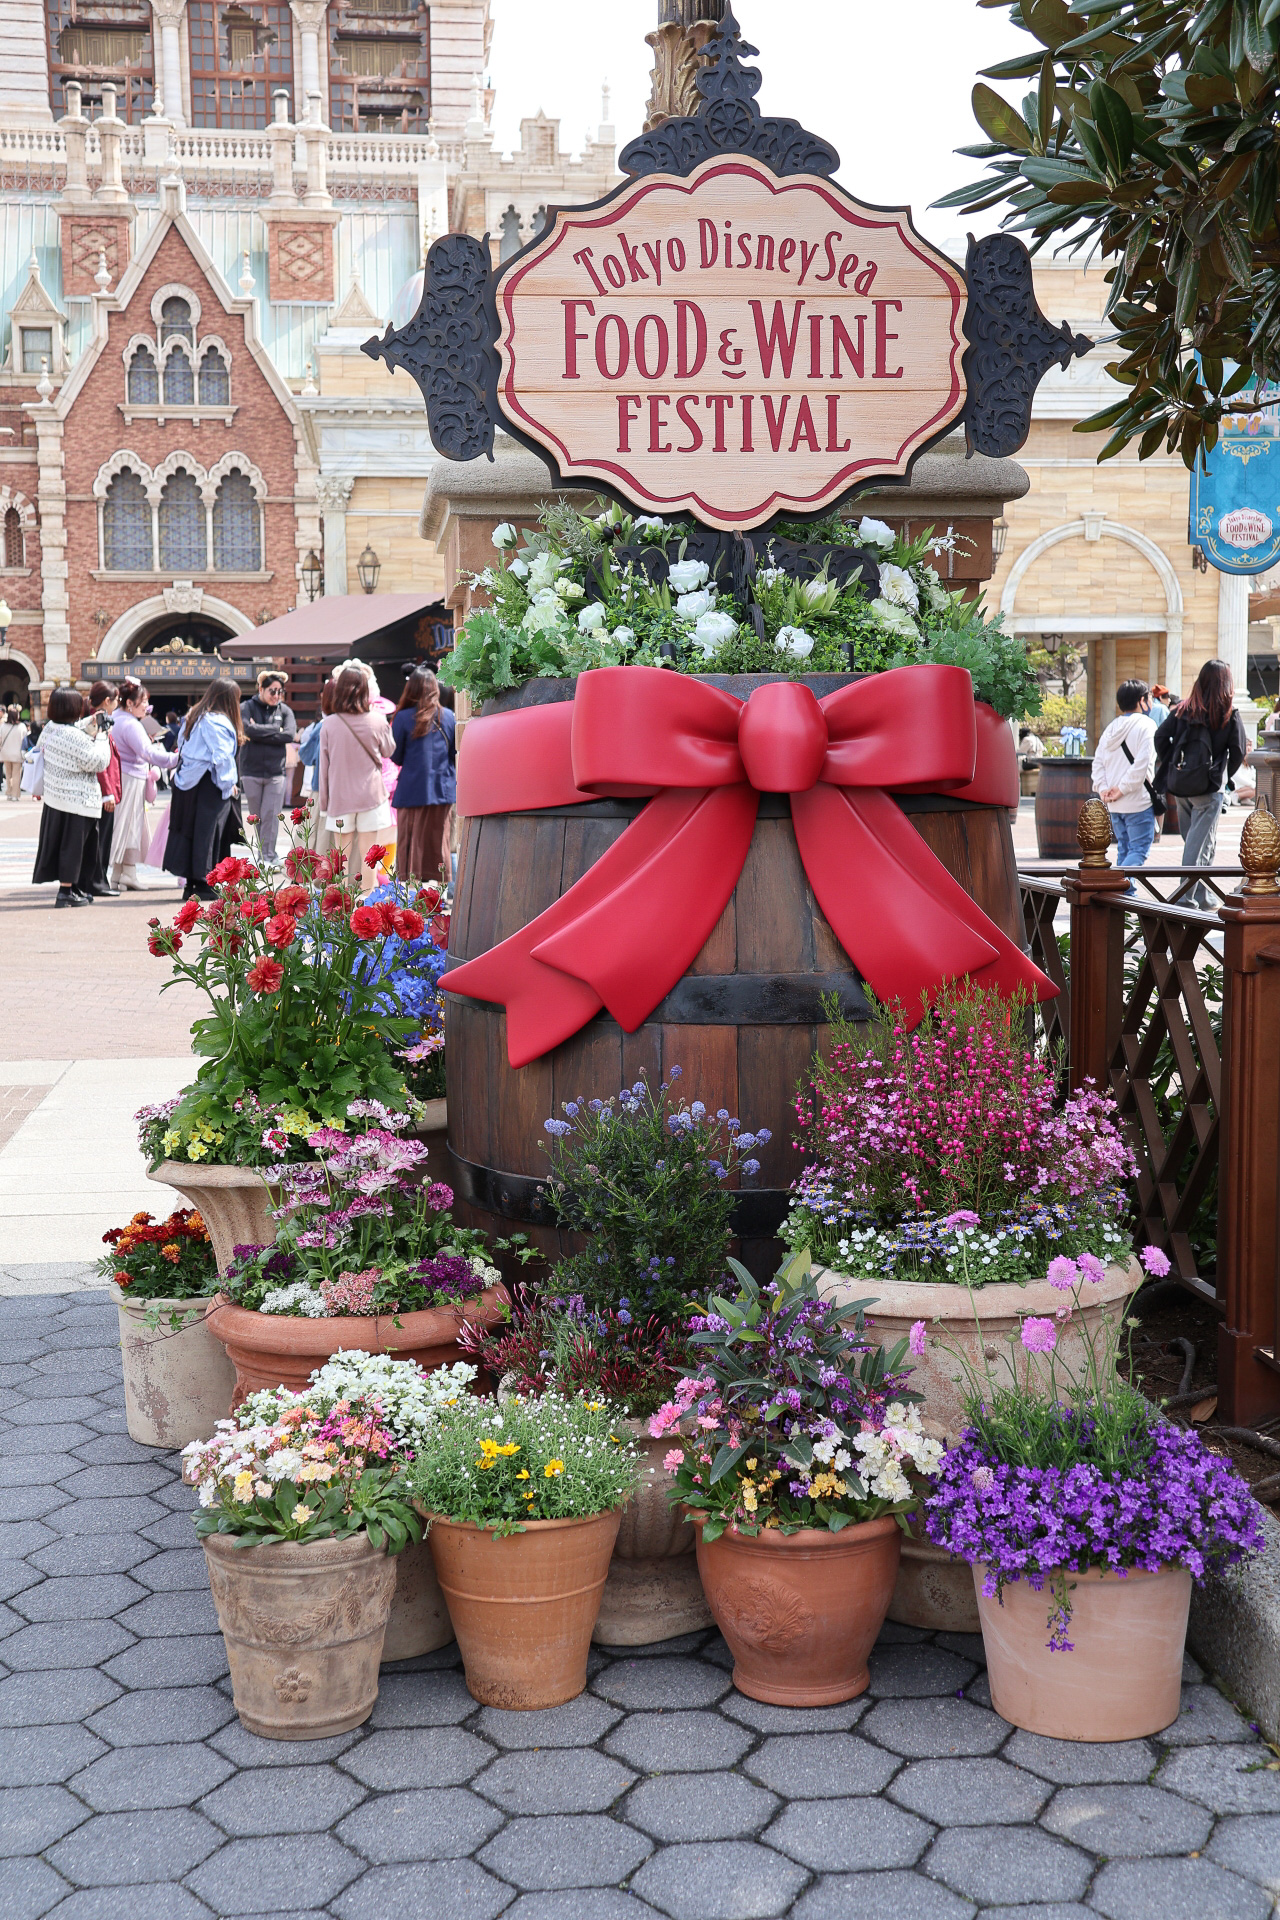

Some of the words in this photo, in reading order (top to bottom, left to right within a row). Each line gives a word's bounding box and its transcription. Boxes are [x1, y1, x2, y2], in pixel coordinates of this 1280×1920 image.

[573, 232, 687, 297] Tokyo
[561, 300, 707, 379] FOOD
[717, 328, 747, 379] &
[748, 300, 904, 379] WINE
[616, 395, 851, 453] FESTIVAL
[107, 666, 247, 676] HIGHTOWER
[144, 658, 211, 666] HOTEL
